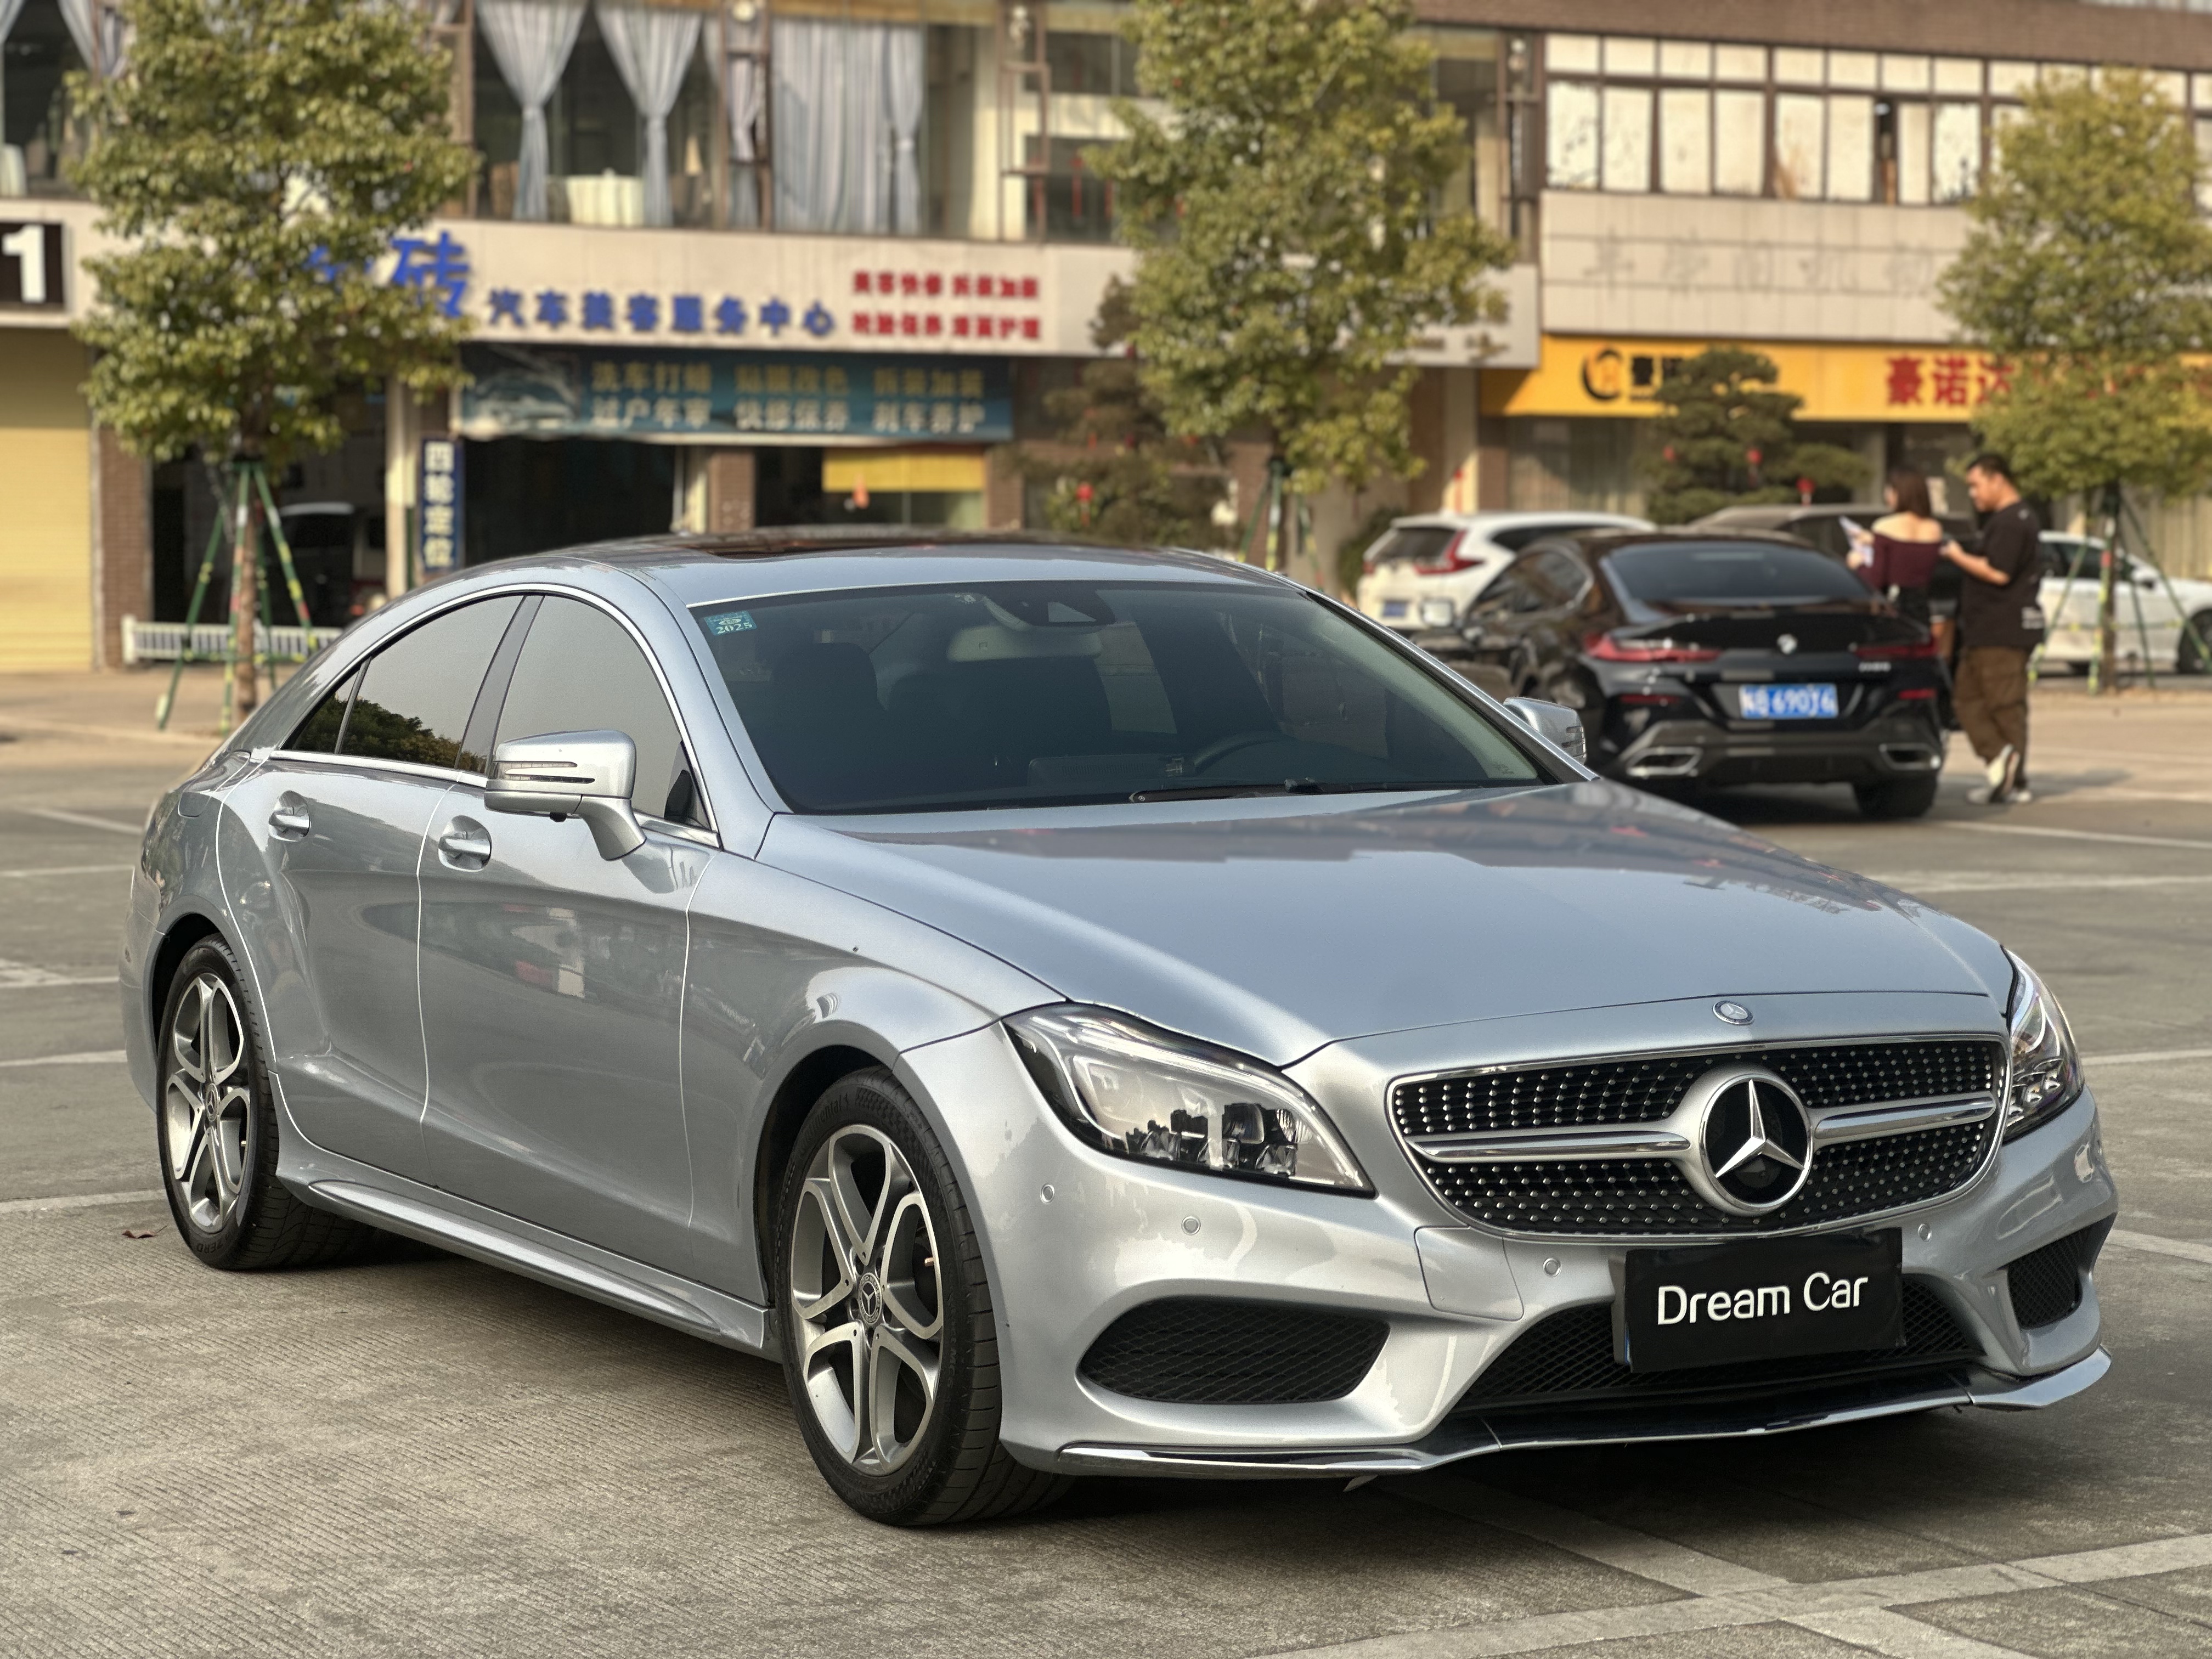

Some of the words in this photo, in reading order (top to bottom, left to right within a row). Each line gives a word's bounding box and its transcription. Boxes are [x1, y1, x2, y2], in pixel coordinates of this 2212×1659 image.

[2, 224, 45, 303] 1
[489, 287, 835, 338] 汽车美容服务中心
[715, 622, 753, 634] 2025
[1657, 1285, 1790, 1325] Dream
[1803, 1271, 1869, 1311] Car
